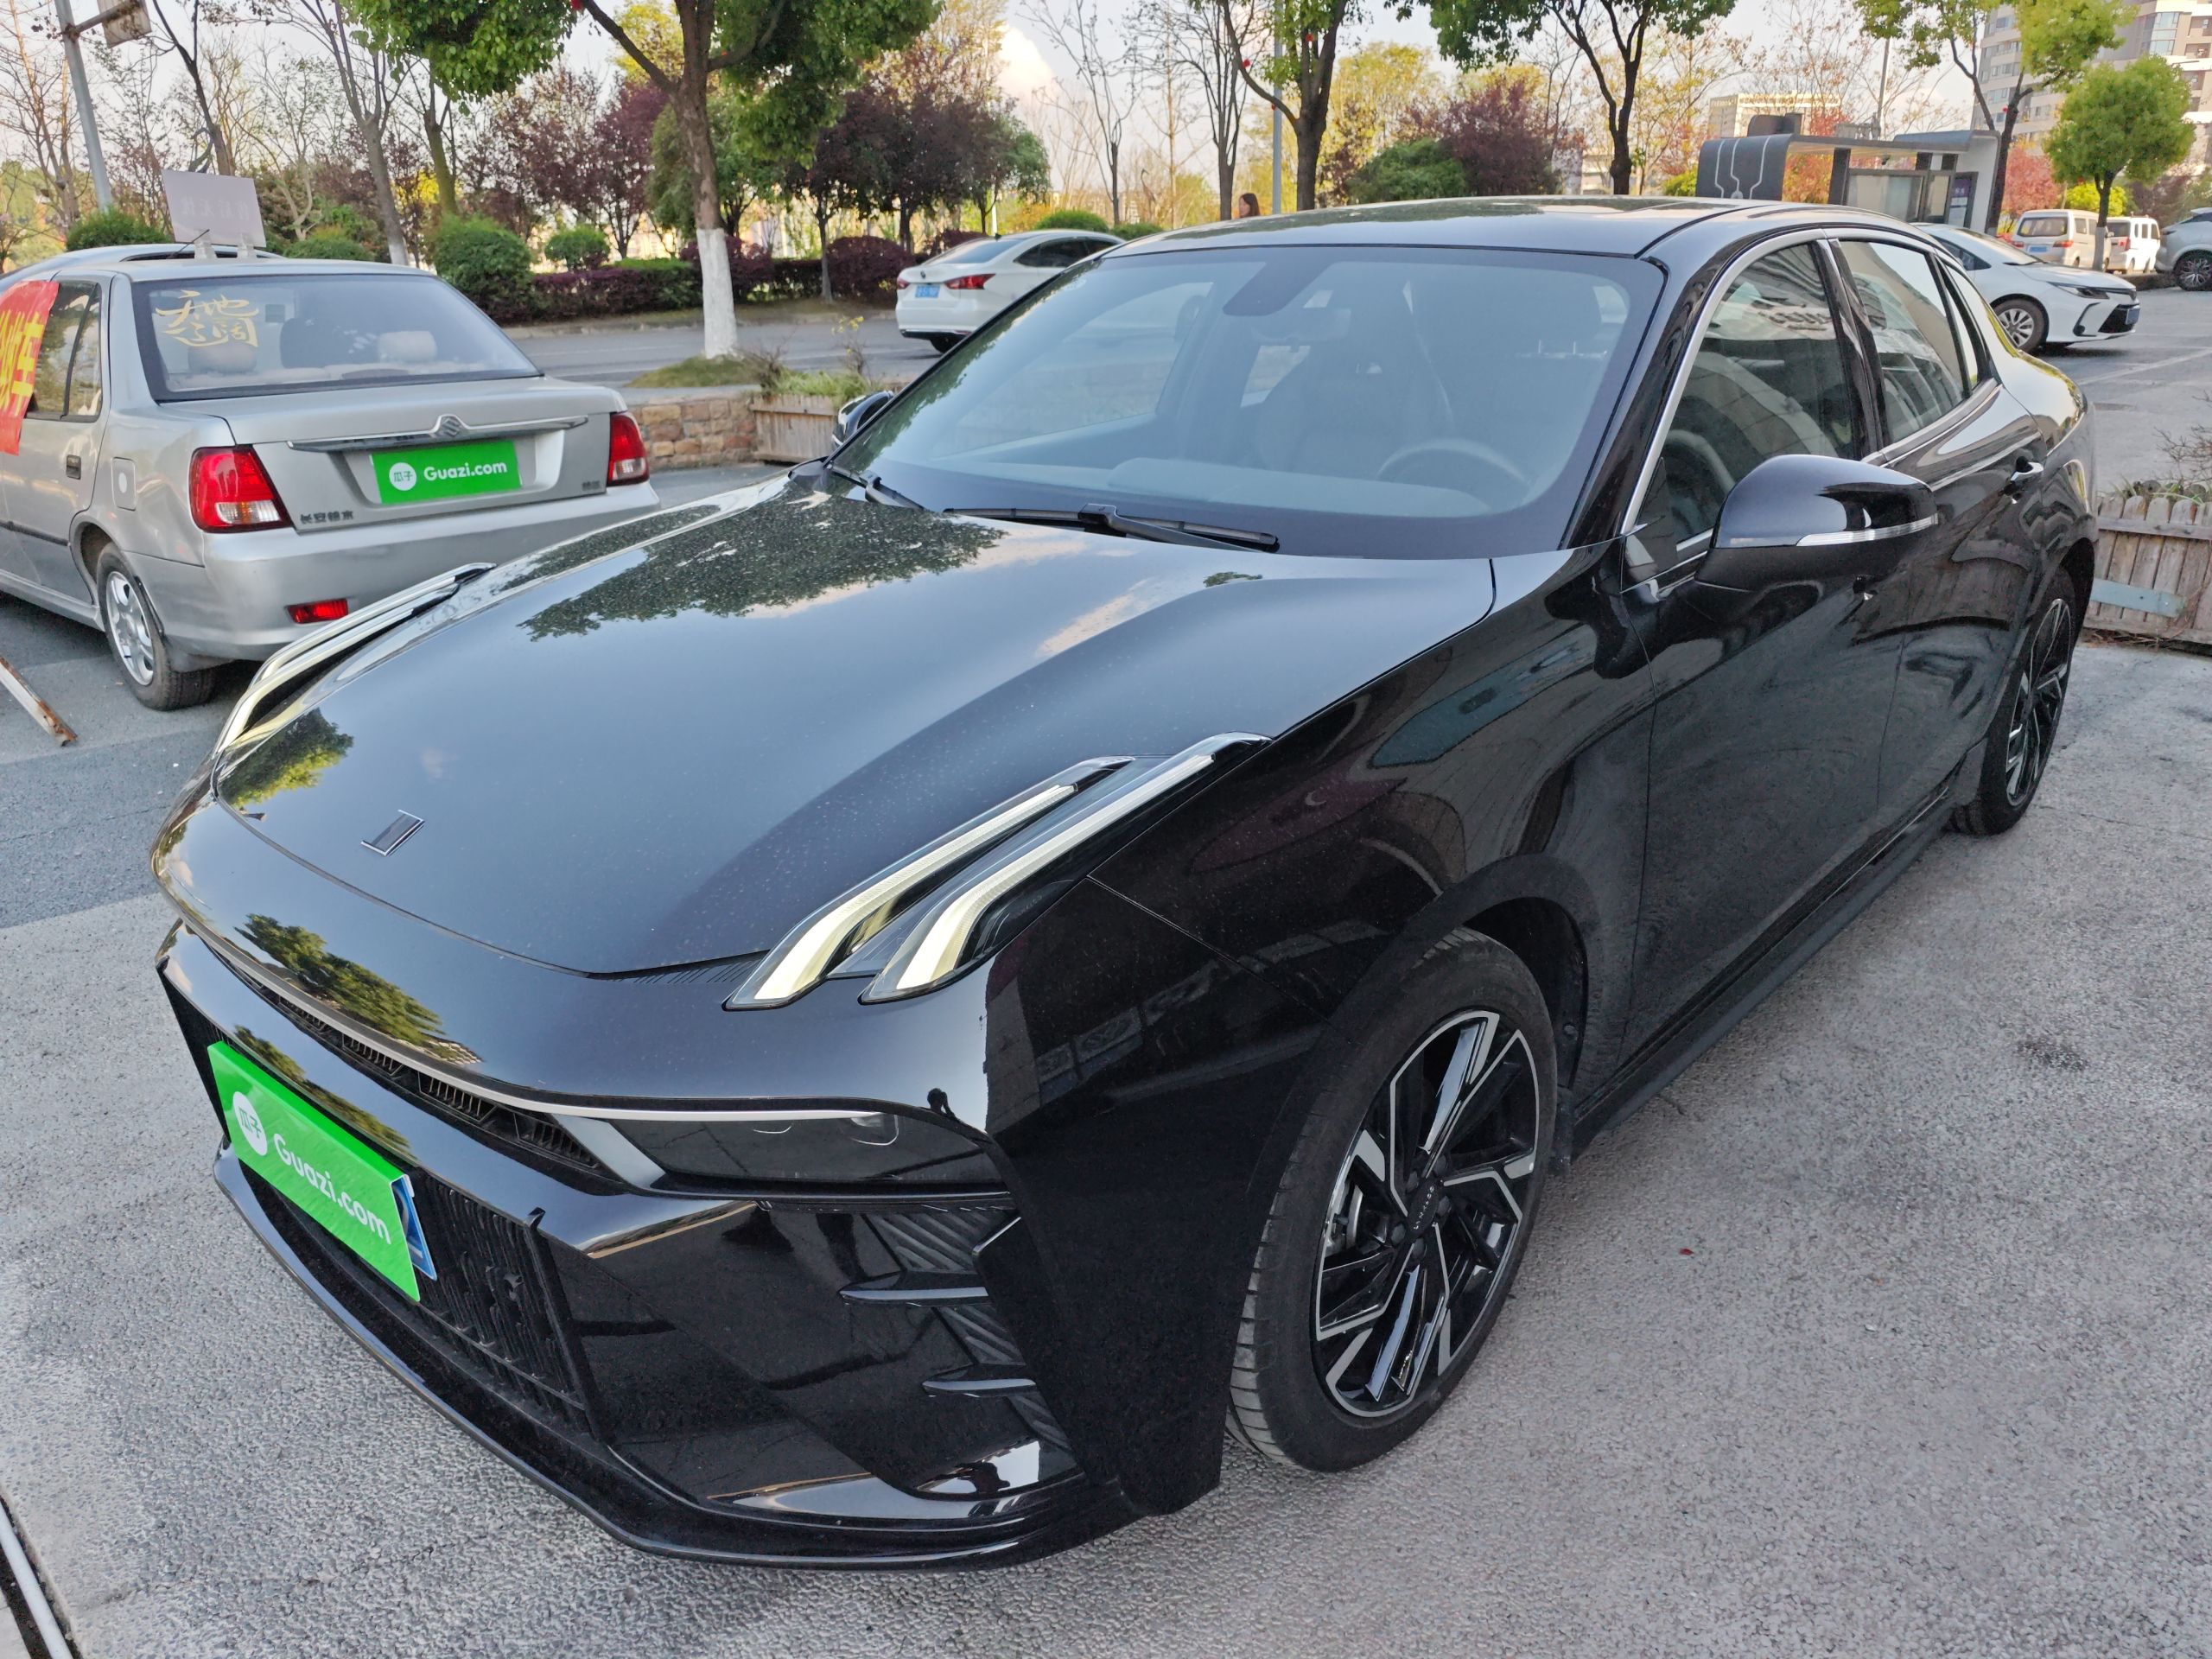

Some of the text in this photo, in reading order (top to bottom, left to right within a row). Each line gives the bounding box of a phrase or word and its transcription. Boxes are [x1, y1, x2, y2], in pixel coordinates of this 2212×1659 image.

[393, 470, 414, 482] 瓜子
[423, 461, 508, 482] Guazi.com
[238, 1106, 263, 1139] 瓜子
[273, 1133, 391, 1245] Guazi.com
